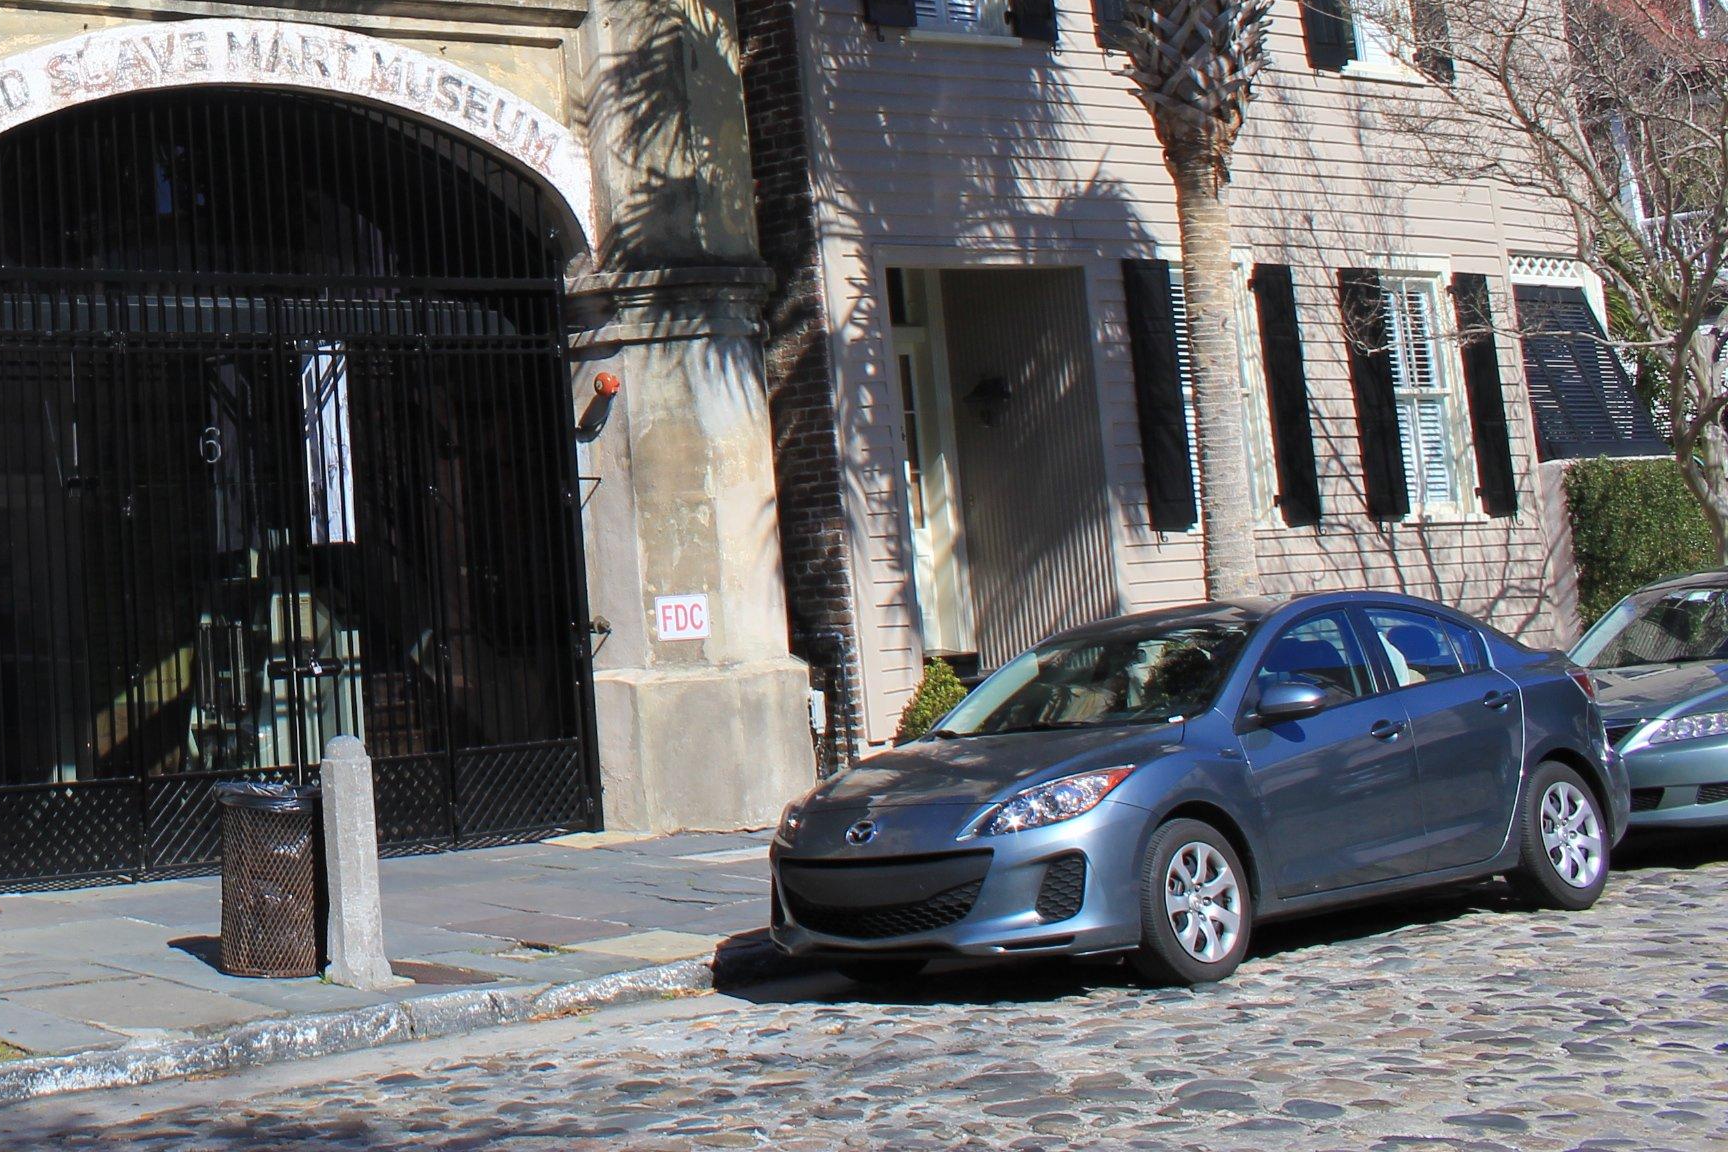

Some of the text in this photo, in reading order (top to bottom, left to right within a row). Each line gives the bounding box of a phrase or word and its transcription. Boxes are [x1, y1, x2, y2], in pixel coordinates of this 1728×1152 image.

[46, 30, 210, 99] SLAVE
[225, 30, 357, 80] MART
[370, 49, 560, 176] MUSEUM
[661, 602, 704, 632] FDC
